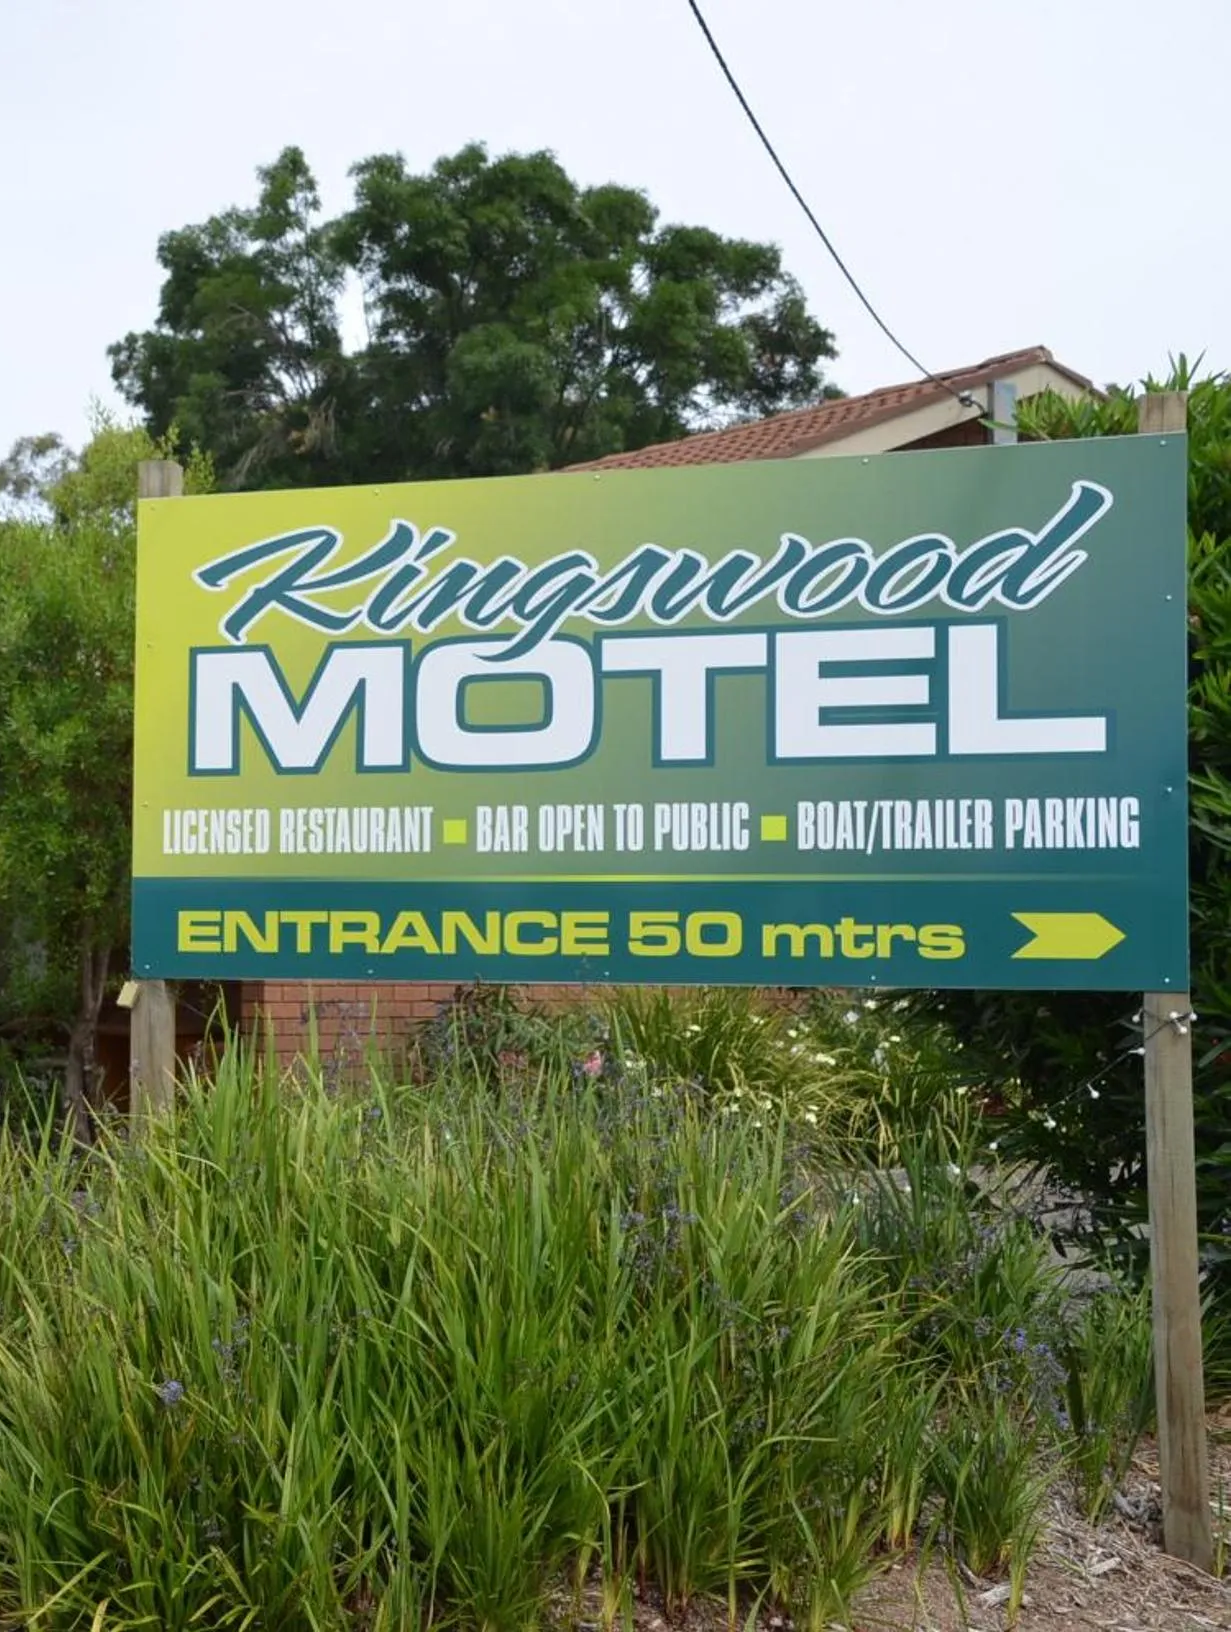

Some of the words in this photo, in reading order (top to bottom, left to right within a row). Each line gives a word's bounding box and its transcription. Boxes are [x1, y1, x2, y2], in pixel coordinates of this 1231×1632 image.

[193, 480, 1113, 662] Kingswood
[190, 620, 1110, 773] MOTEL
[163, 808, 270, 854] LICENSED
[280, 806, 433, 853] RESTAURANT
[476, 805, 529, 852] BAR
[539, 804, 604, 852] OPEN
[613, 803, 644, 851] TO
[654, 802, 749, 851] PUBLIC
[797, 799, 994, 854] BOAT/TRAILER
[1005, 797, 1139, 849] PARKING
[177, 910, 610, 956] ENTRANCE
[628, 911, 743, 957] 50
[762, 917, 965, 959] mtrs
